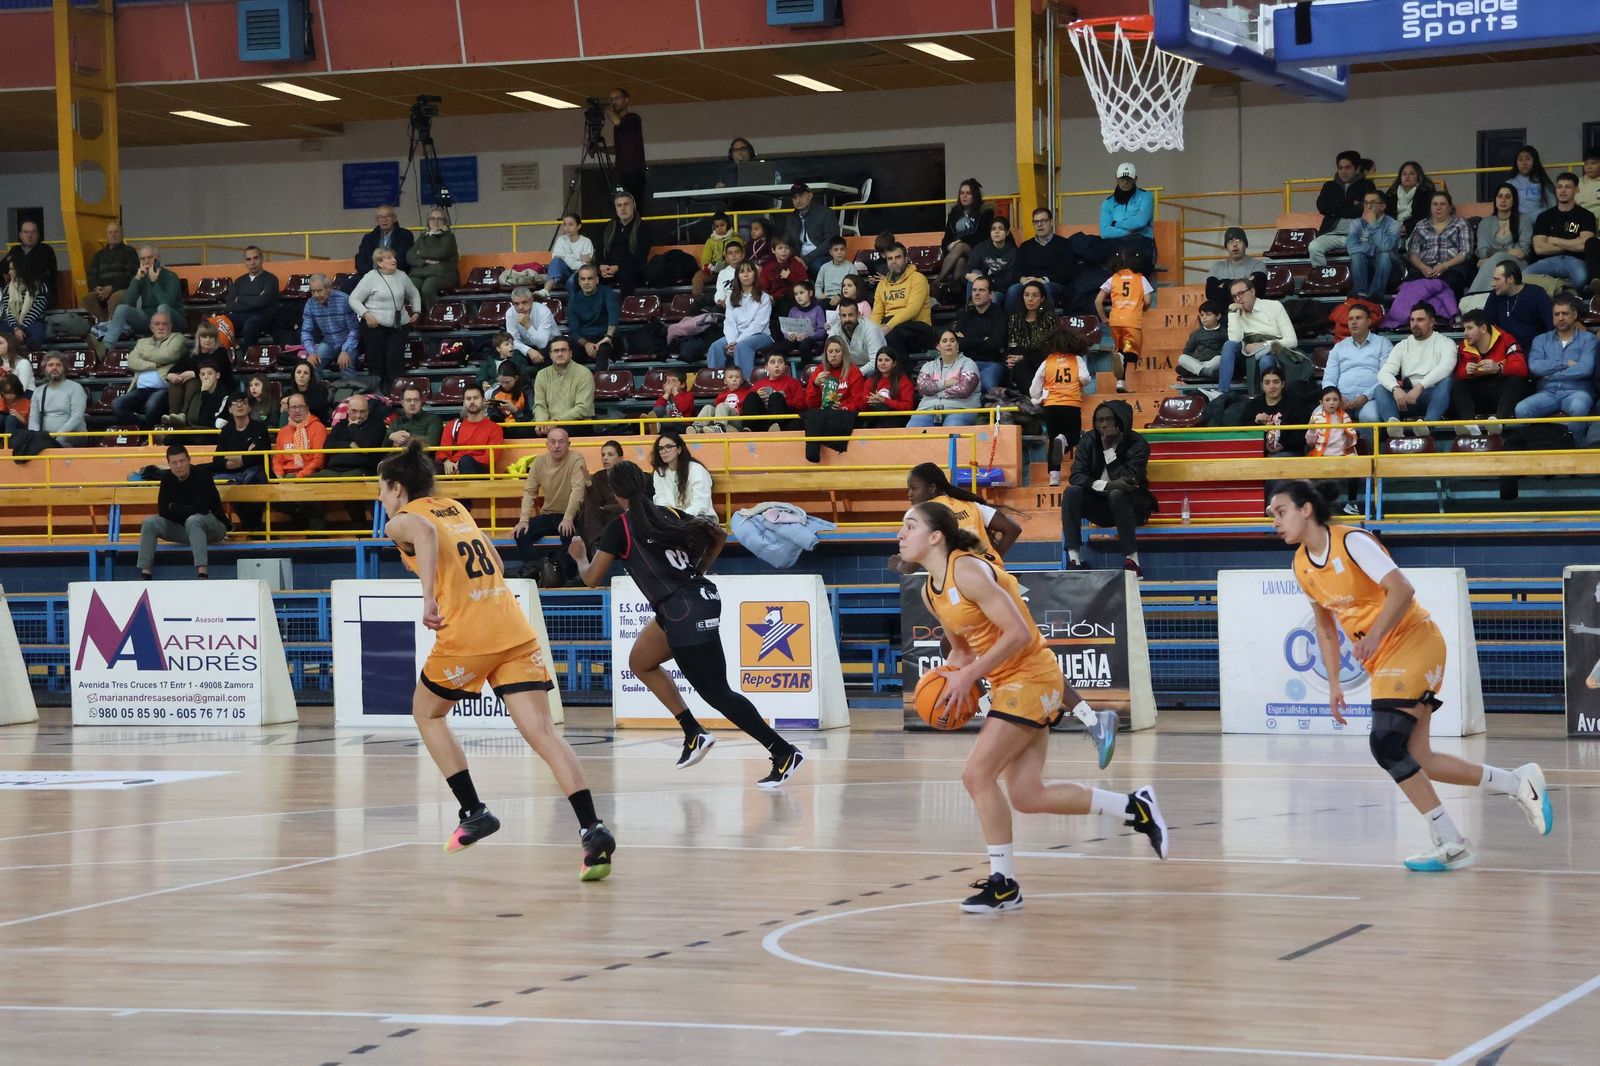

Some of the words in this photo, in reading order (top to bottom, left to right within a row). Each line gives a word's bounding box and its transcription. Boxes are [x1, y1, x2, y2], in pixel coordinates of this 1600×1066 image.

[1402, 13, 1518, 42] Sports
[1290, 231, 1305, 242] 27
[883, 287, 906, 301] VANS
[1121, 281, 1130, 298] 5
[638, 299, 646, 308] 7
[610, 373, 618, 383] 9
[1055, 367, 1071, 384] 45
[457, 538, 496, 579] 28
[1262, 580, 1304, 595] LAVANDER
[619, 603, 633, 613] E.S.
[635, 603, 654, 613] CAM
[1057, 648, 1112, 679] UEÑA
[78, 681, 110, 689] Avenida
[111, 681, 128, 689] Tres
[130, 681, 158, 689] Cruces
[160, 681, 168, 689] 17
[170, 681, 186, 689] Entr
[199, 681, 222, 689] 49008
[224, 681, 254, 689] Zamora
[742, 673, 811, 688] RepoSTAR
[99, 693, 246, 704] marianandresasesoria@gmail.com
[98, 708, 117, 719] 980
[120, 708, 134, 719] 05
[137, 708, 150, 719] 85
[153, 708, 166, 719] 90
[176, 708, 197, 719] 605
[200, 708, 214, 719] 76
[216, 708, 228, 719] 71
[232, 708, 246, 719] 05
[1267, 704, 1309, 715] Especialistas
